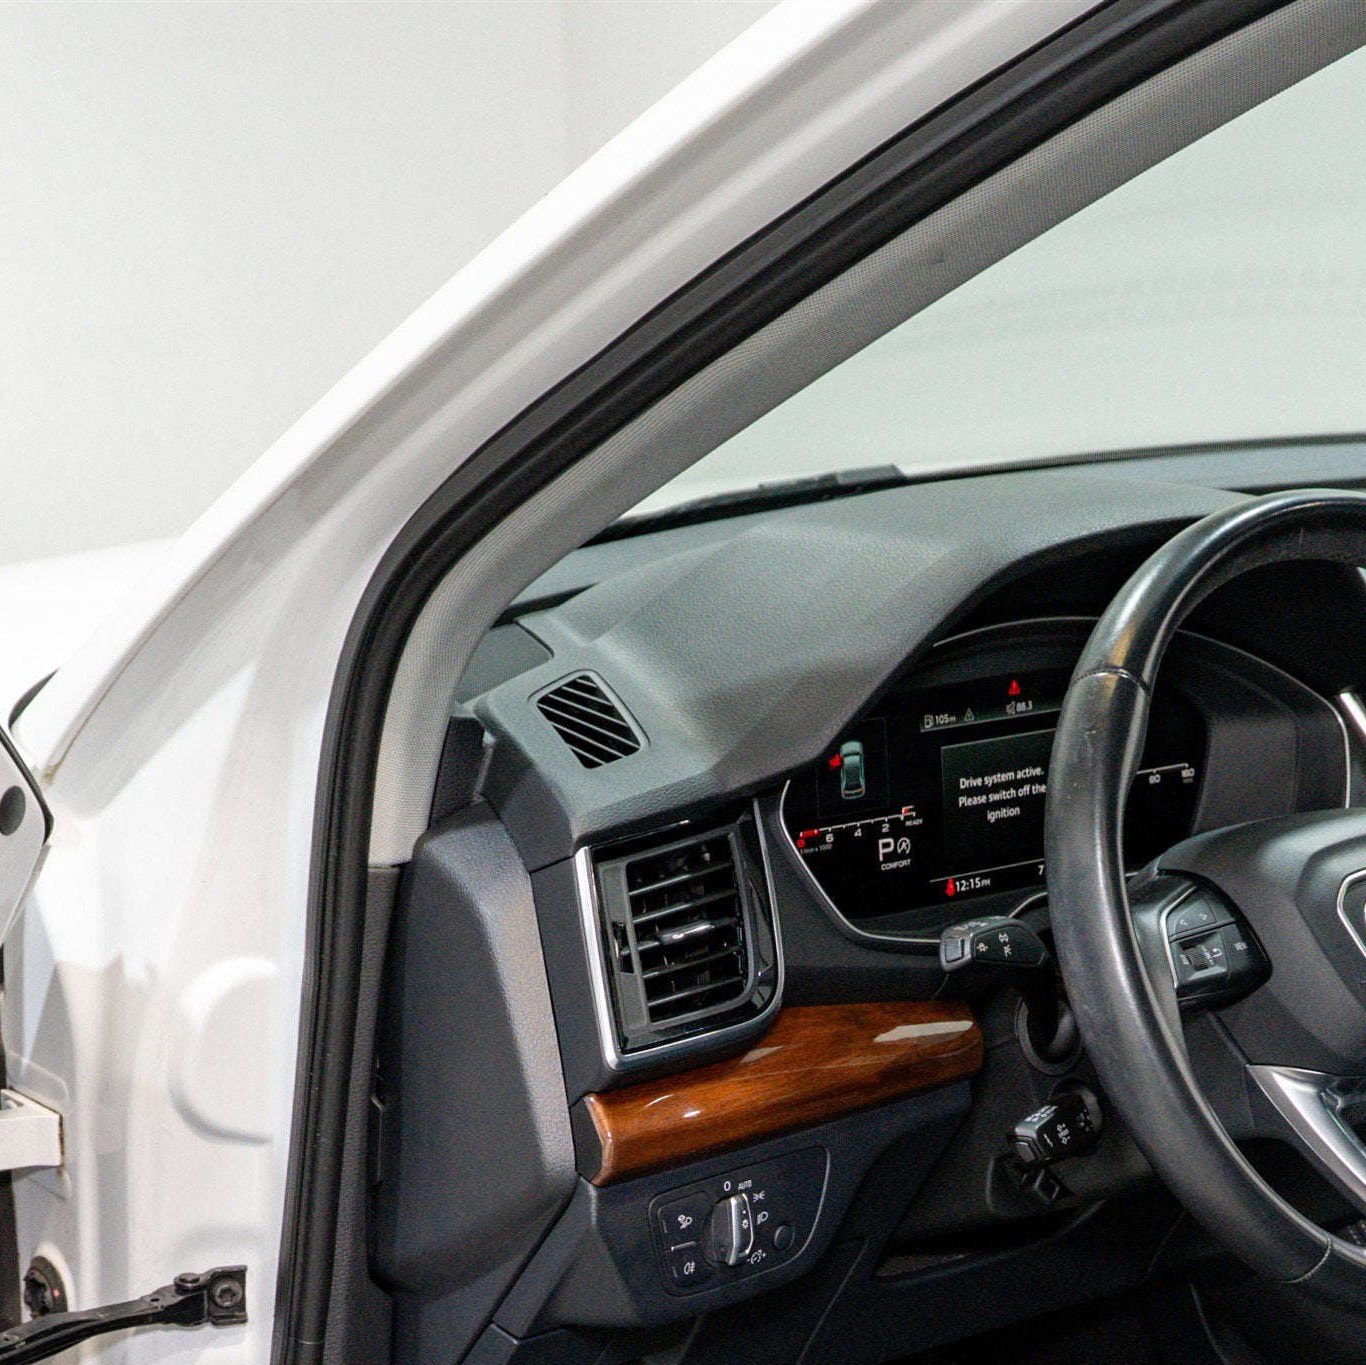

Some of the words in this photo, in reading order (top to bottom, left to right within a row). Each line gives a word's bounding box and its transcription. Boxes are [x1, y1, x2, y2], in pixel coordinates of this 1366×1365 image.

[1016, 700, 1033, 712] 88.3
[959, 776, 983, 790] Drive
[984, 771, 1015, 787] system
[1016, 765, 1045, 780] active.
[958, 795, 987, 808] Please
[988, 787, 1017, 803] switch
[1018, 784, 1031, 797] off
[1032, 783, 1047, 794] the
[986, 805, 1021, 823] ignition
[854, 828, 862, 837] 4
[881, 823, 890, 833] 2
[825, 833, 834, 843] 6
[878, 837, 895, 861] P
[880, 859, 912, 871] COMFORT
[738, 1179, 753, 1191] AUTO
